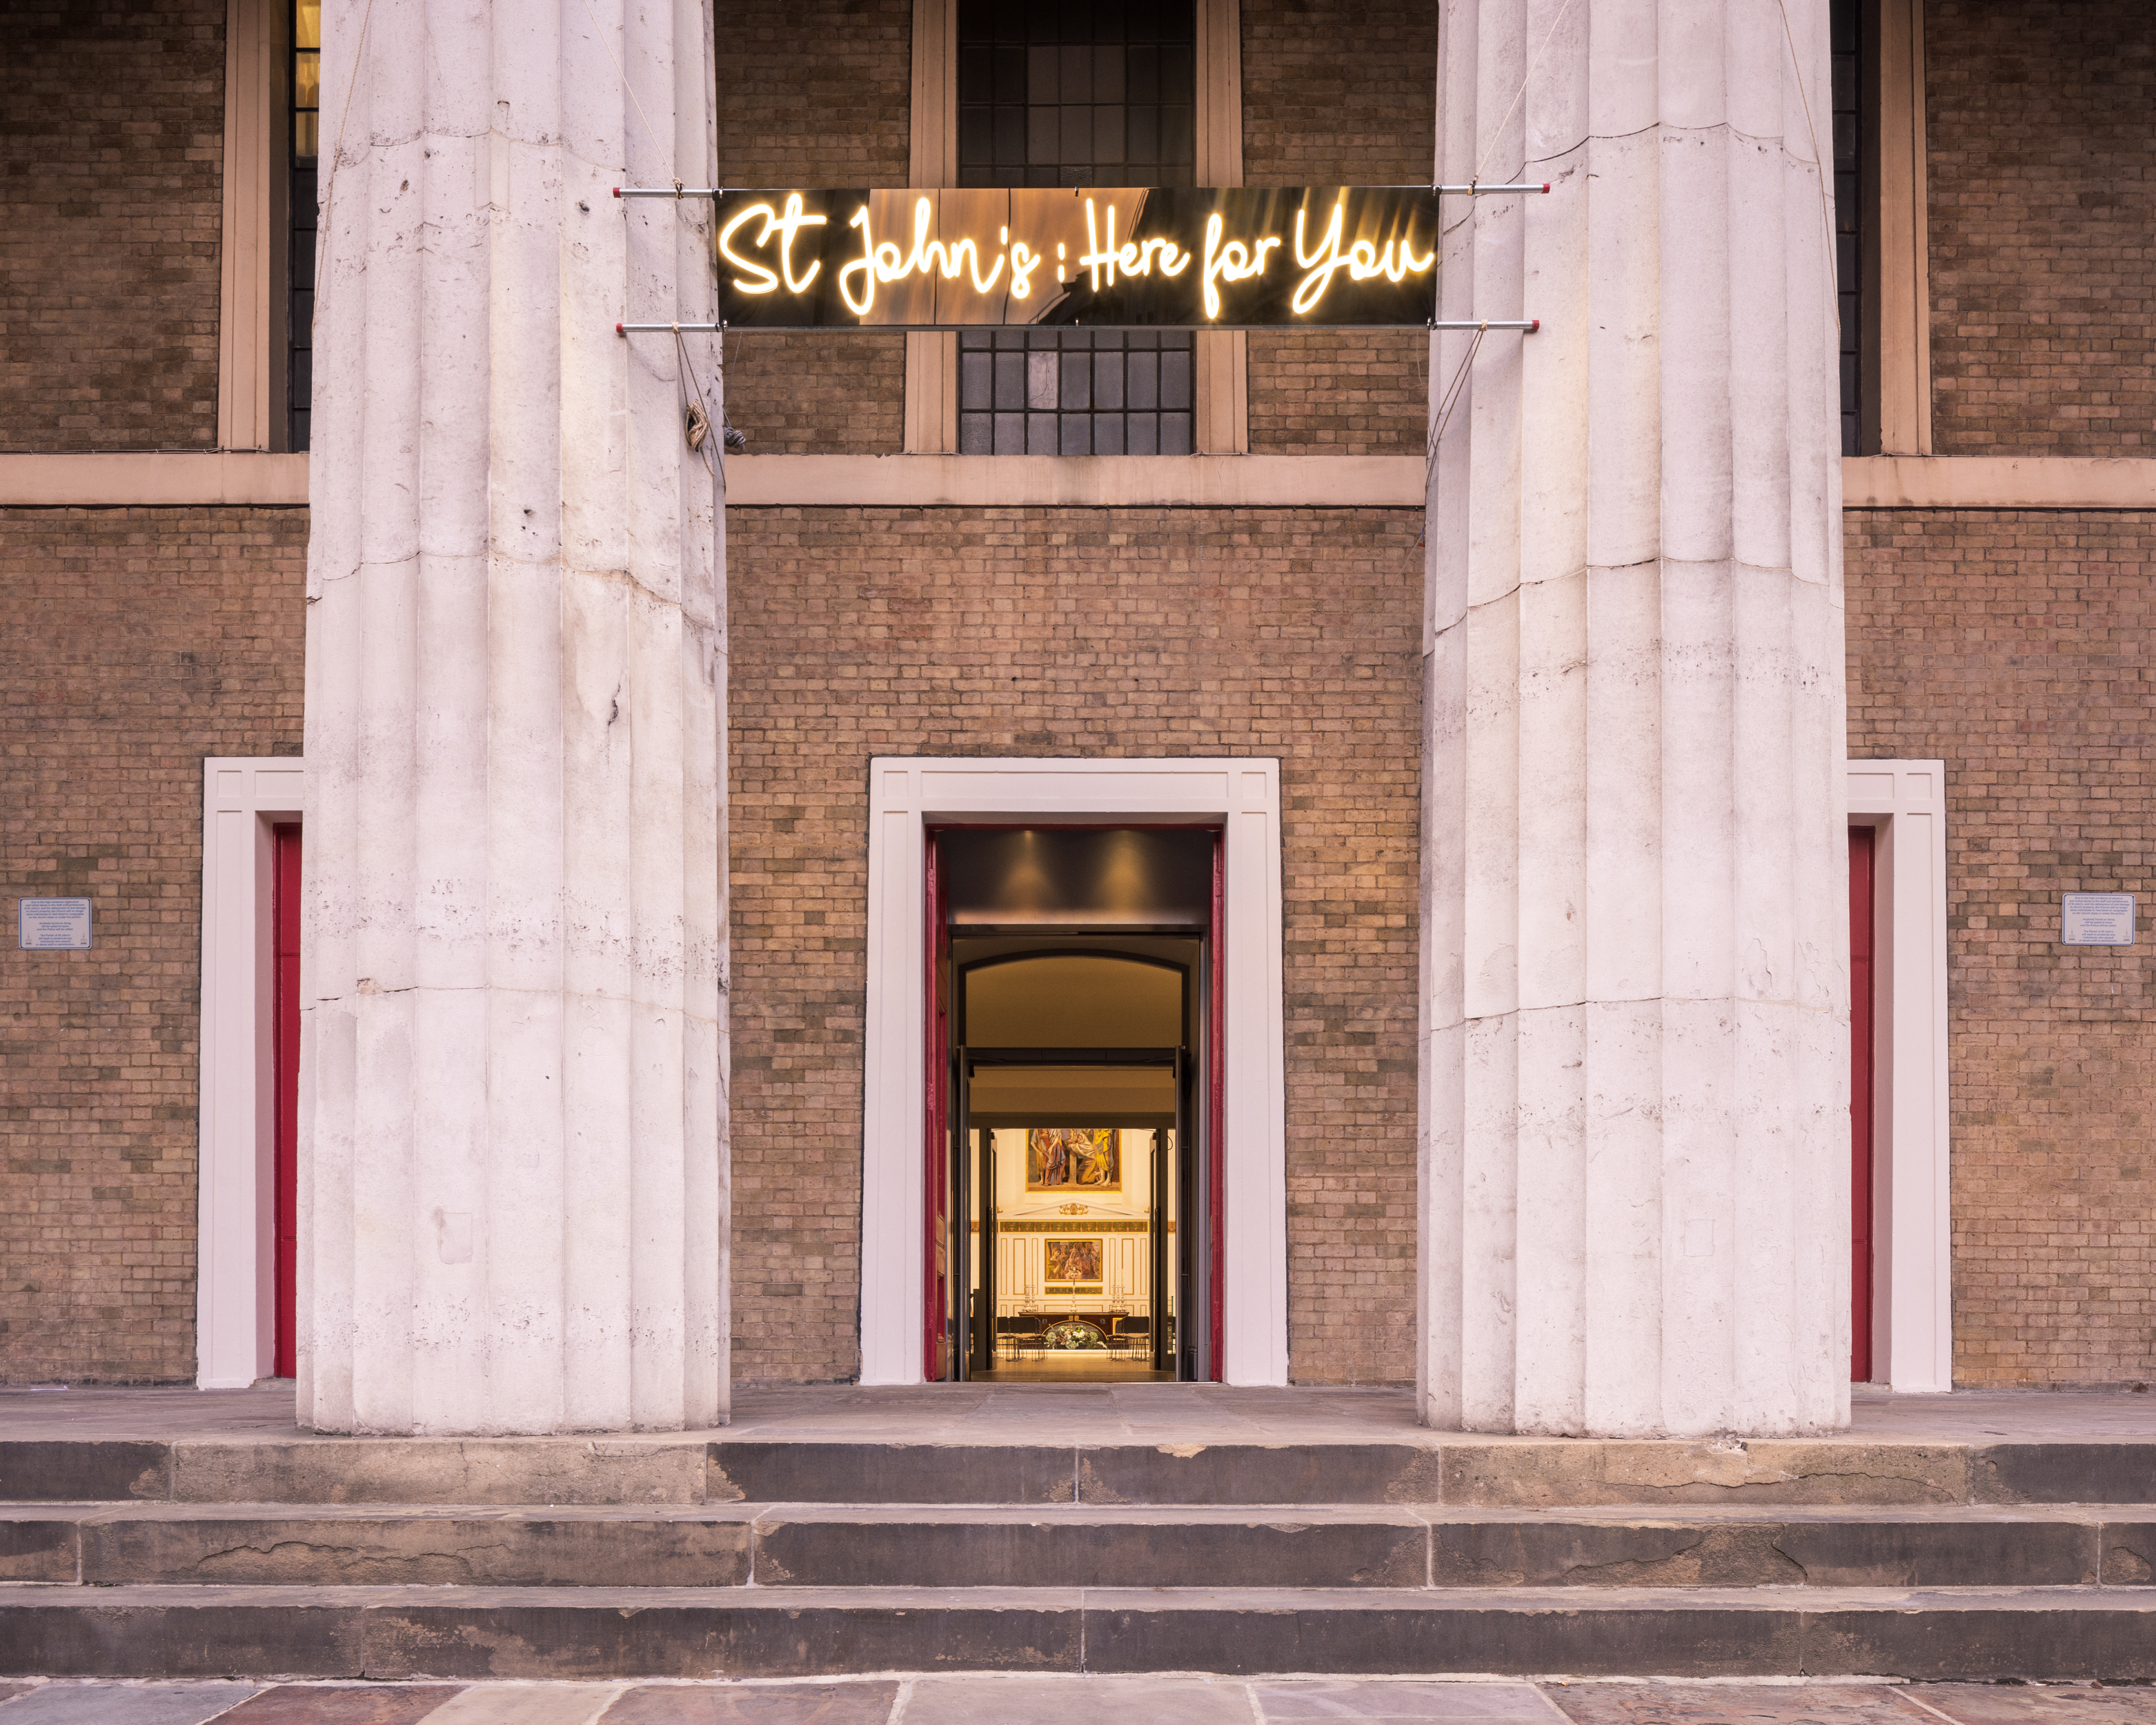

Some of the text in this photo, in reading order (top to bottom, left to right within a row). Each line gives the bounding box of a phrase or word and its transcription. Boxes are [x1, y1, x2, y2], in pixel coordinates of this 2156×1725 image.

[720, 193, 827, 294] St
[840, 197, 1040, 315] John's
[1080, 198, 1191, 293] Here
[1203, 213, 1281, 319] for
[1292, 204, 1434, 314] You
